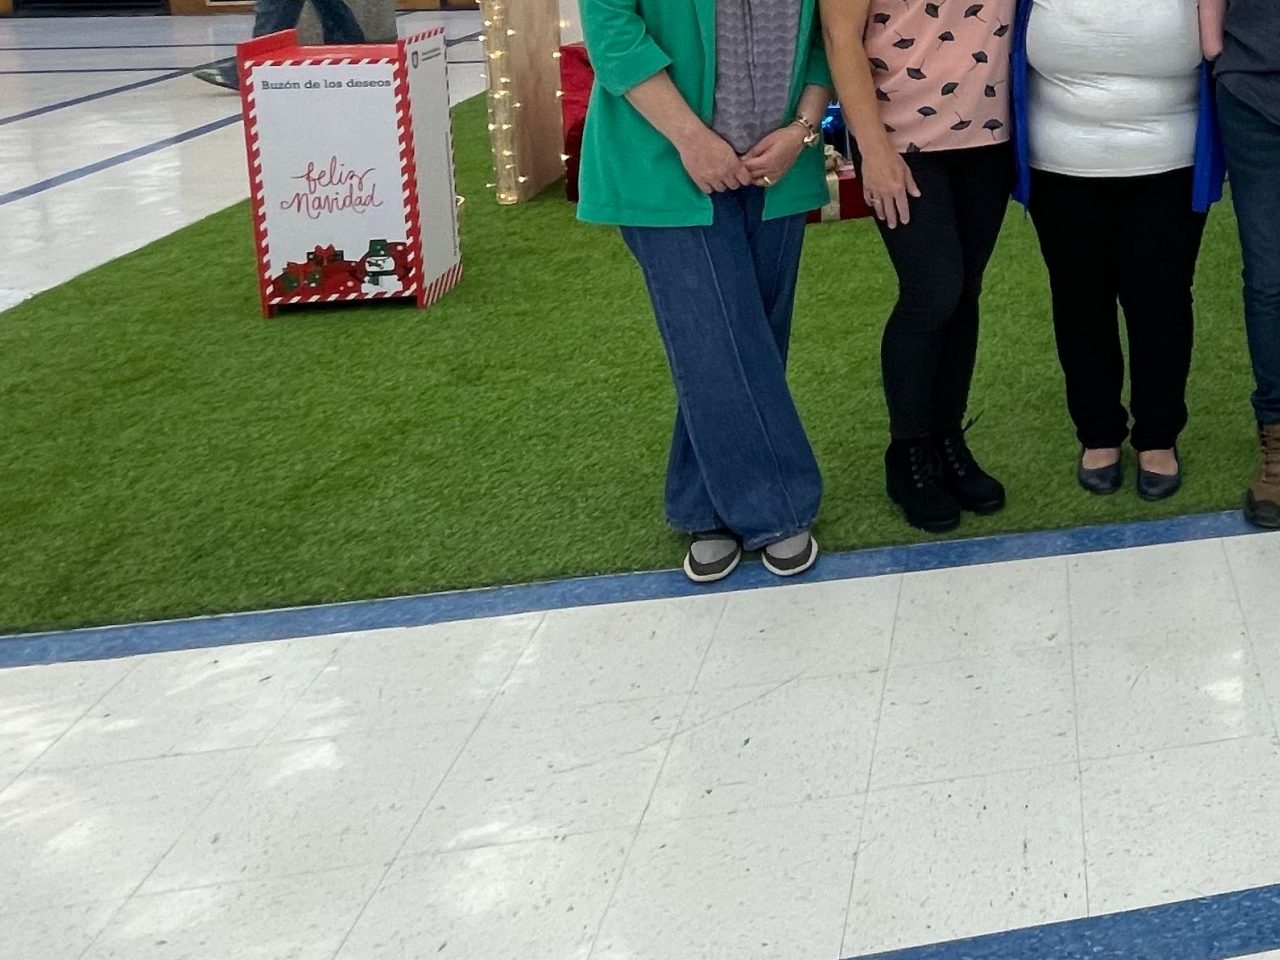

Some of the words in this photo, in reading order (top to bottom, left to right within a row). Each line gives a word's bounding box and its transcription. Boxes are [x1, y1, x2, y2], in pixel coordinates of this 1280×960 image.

[261, 79, 301, 90] Buzón
[304, 79, 321, 89] de
[324, 79, 343, 88] los
[346, 78, 391, 88] deseos
